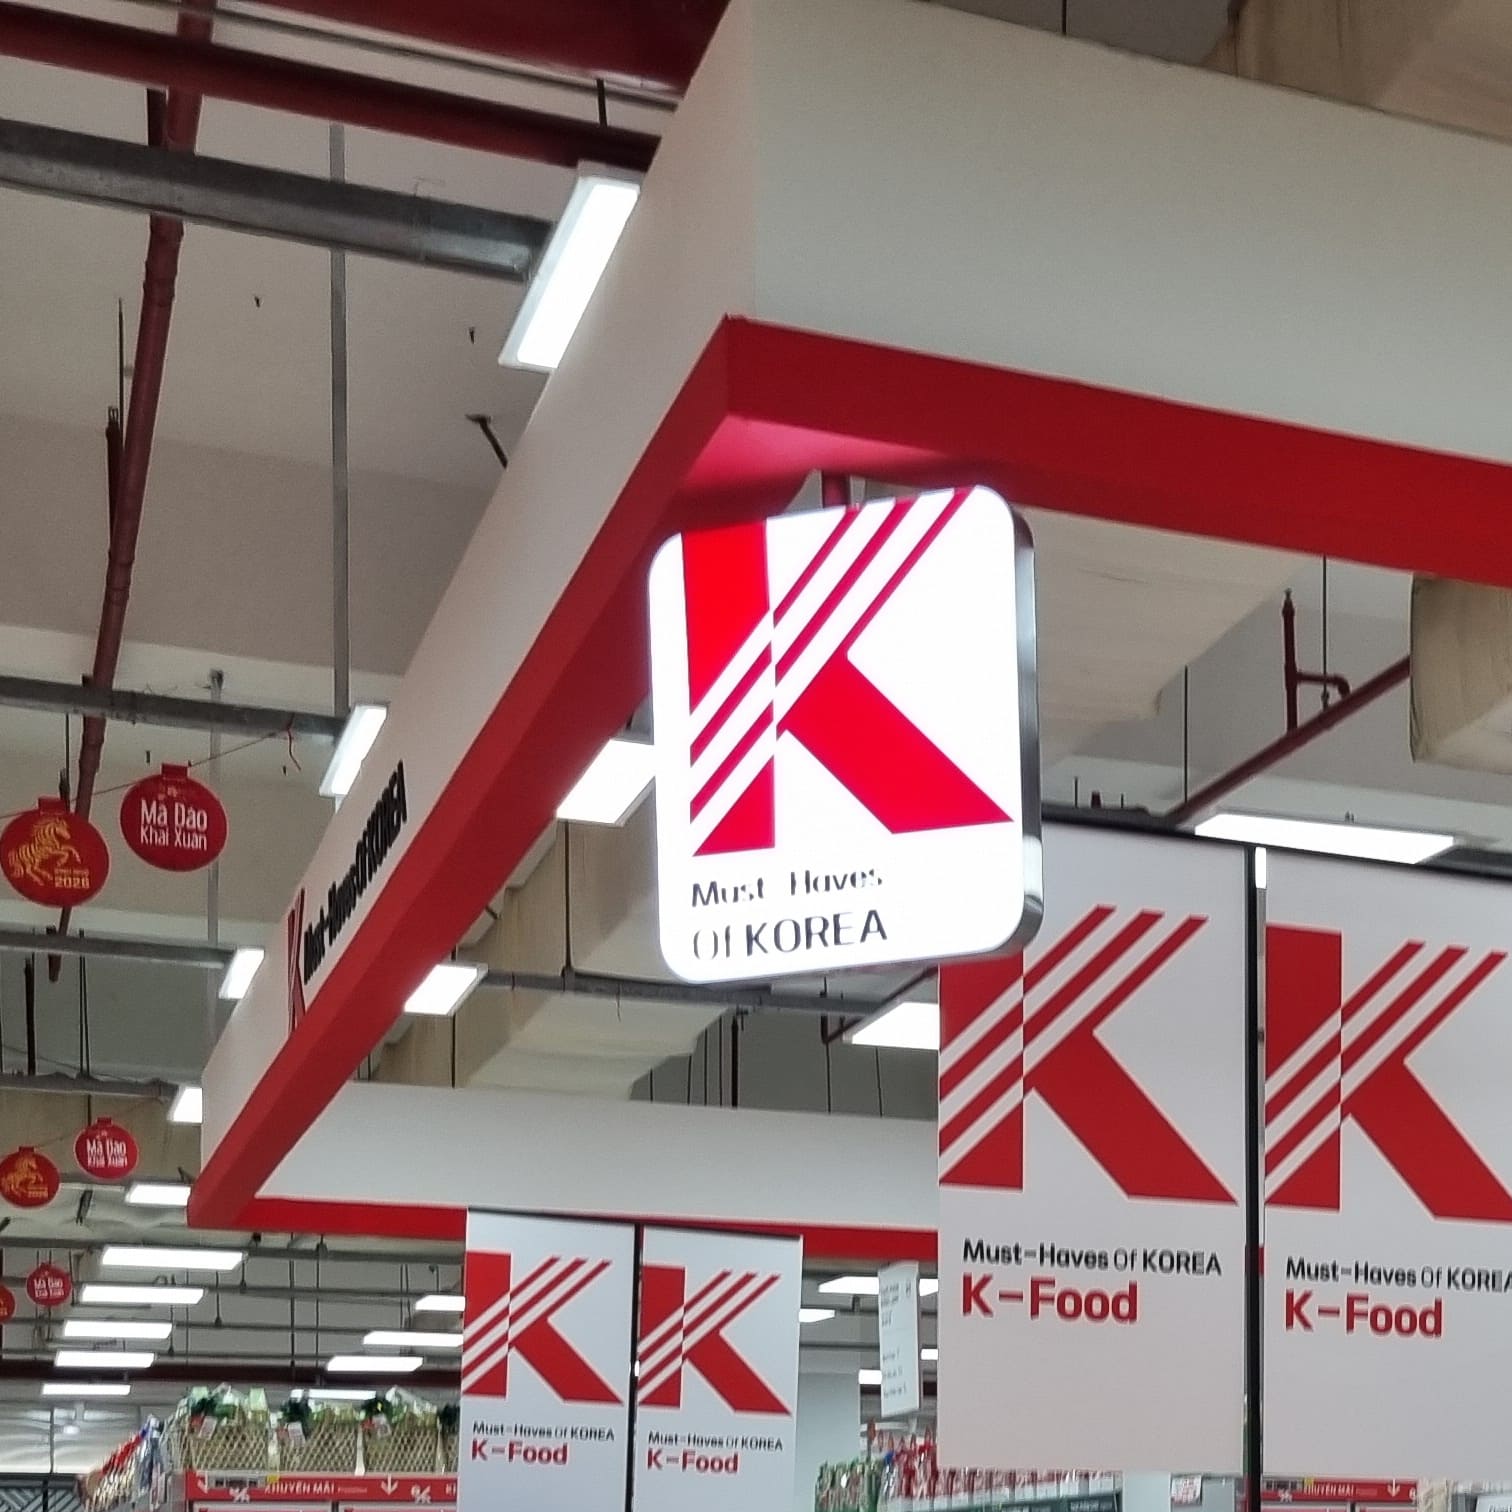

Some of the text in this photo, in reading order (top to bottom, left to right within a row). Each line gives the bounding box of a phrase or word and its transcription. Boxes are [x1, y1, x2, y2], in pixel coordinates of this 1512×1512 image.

[693, 910, 887, 960] Of KOREA
[962, 1238, 1222, 1275] Must-Haves Of KOREA
[1285, 1257, 1417, 1287] Must-Haves
[1420, 1267, 1442, 1288] Of
[962, 1273, 1139, 1323] K-Food
[1285, 1290, 1443, 1338] K-Food
[473, 1421, 552, 1438] Must-Haves
[570, 1426, 615, 1441] KOREA
[648, 1431, 724, 1449] Must-Haves
[741, 1437, 783, 1451] KOREA
[471, 1440, 568, 1465] K-Food
[647, 1449, 739, 1474] K-Food
